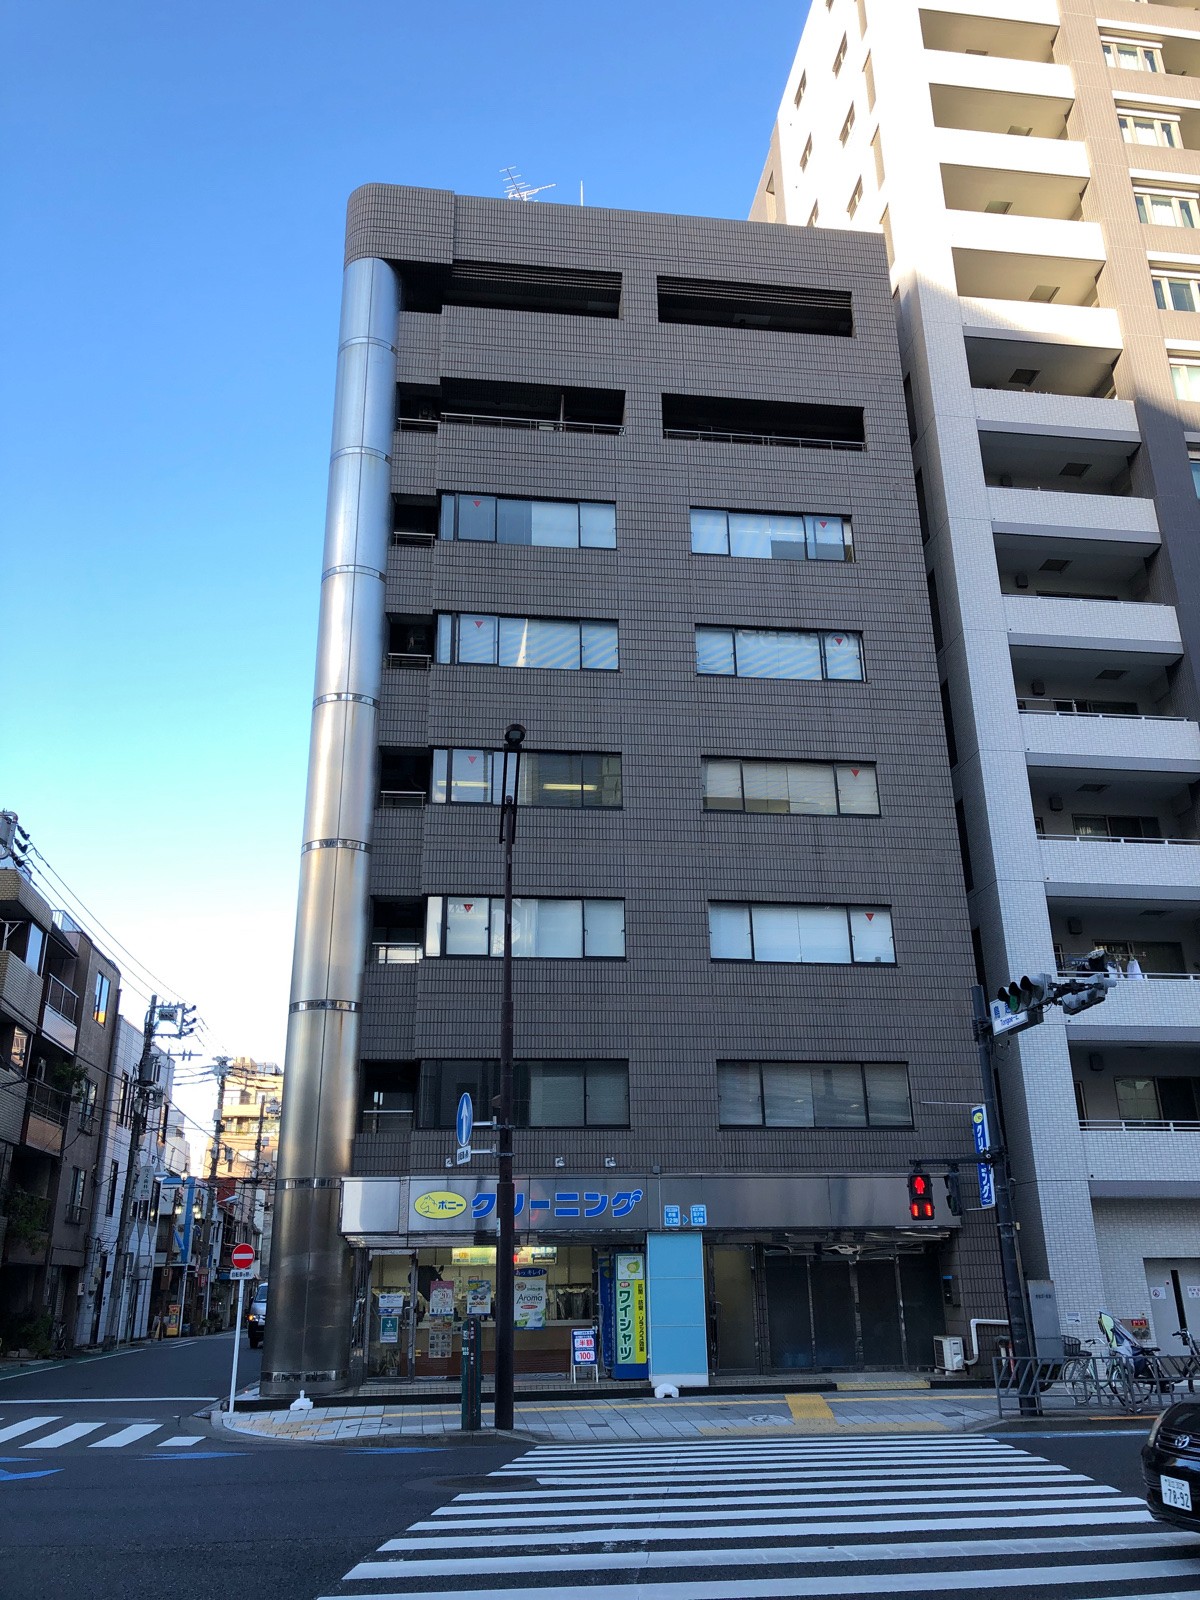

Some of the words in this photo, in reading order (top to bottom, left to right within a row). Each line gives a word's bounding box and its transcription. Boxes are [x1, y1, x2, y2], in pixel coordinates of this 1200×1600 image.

[619, 1290, 632, 1361] ワイシャツ
[1167, 1488, 1190, 1508] 78-92
